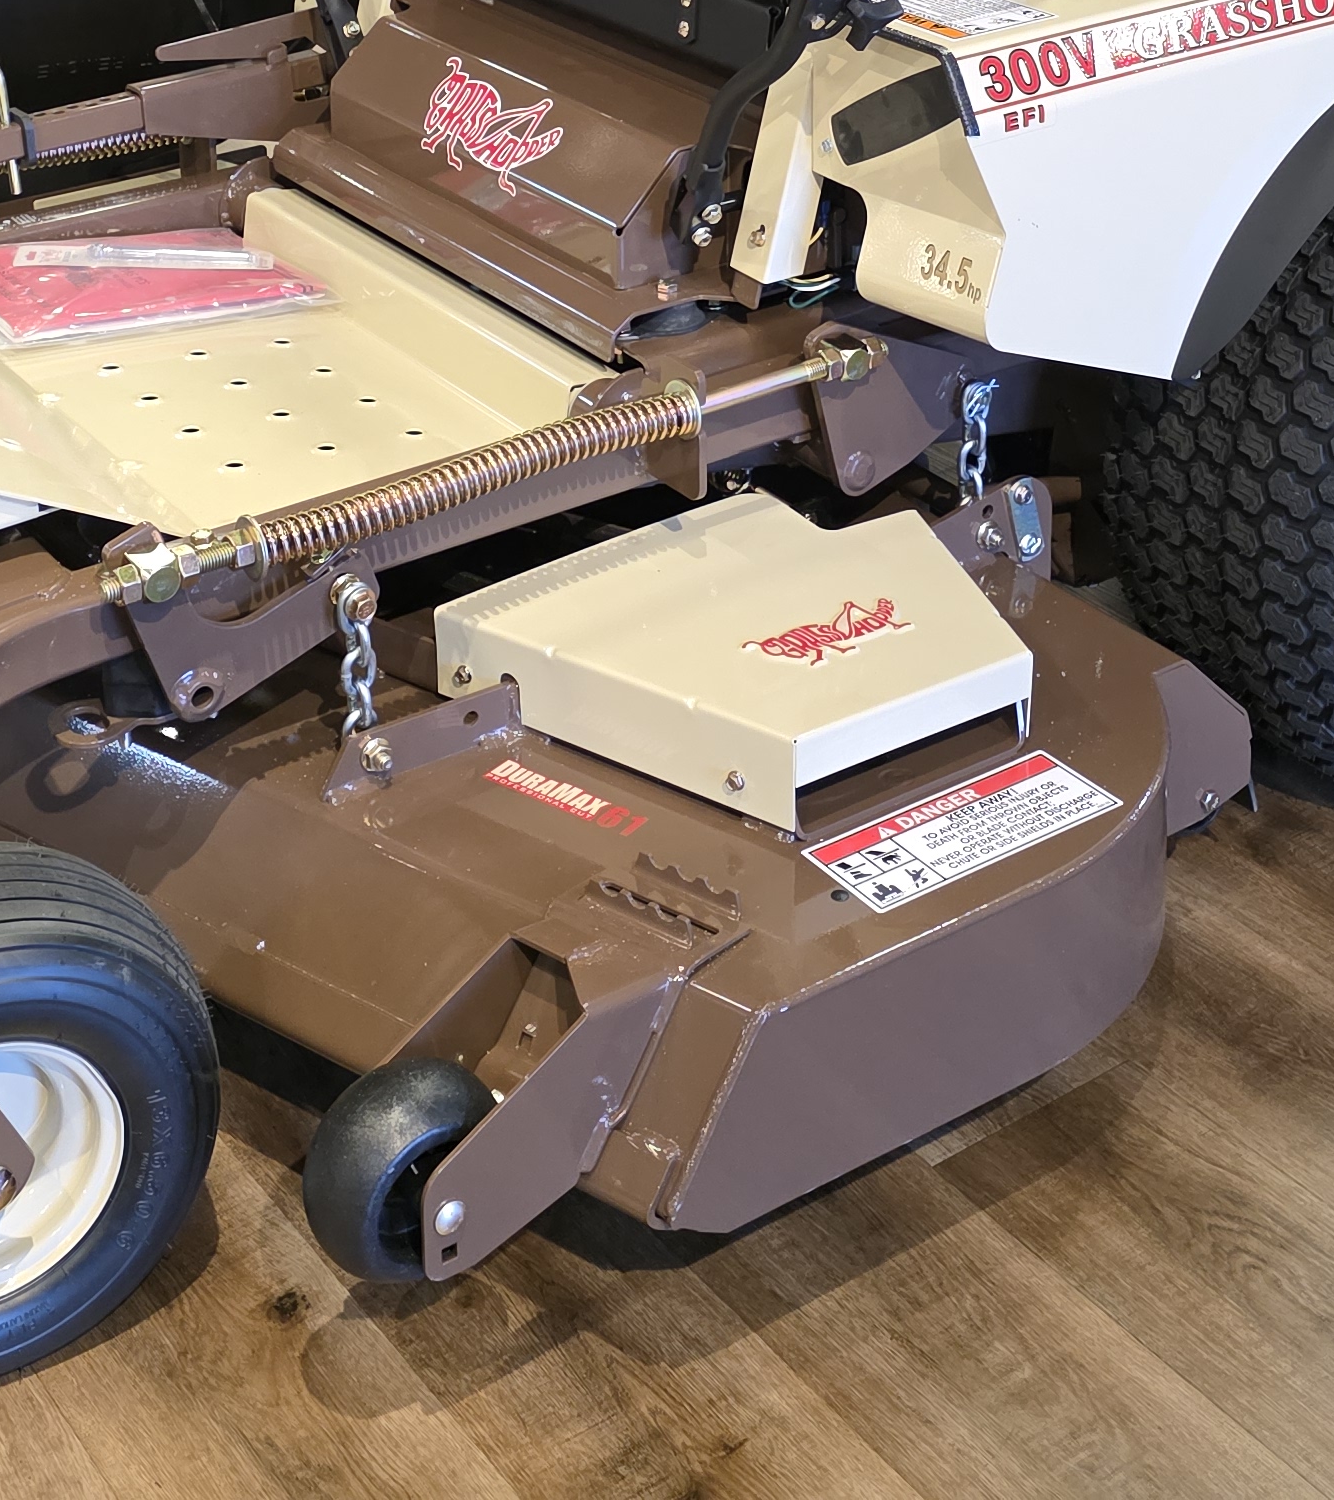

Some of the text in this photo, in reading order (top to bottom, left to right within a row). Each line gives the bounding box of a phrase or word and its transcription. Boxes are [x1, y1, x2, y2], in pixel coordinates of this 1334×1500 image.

[979, 30, 1097, 103] 300V
[1003, 104, 1046, 133] EFI
[484, 772, 594, 821] PROFESSIONAL CUT
[490, 759, 649, 837] DURAMAX 61
[898, 788, 982, 830] DANGER
[922, 780, 1057, 842] TO AVOID SERIOUS INJURY OR
[926, 784, 1069, 851] DEATH FROM THROWN OBJECTS
[945, 788, 1019, 823] KEEP AWAY!
[929, 850, 963, 868] NEVER
[962, 832, 1004, 853] OPERATE
[1003, 812, 1045, 834] WITHOUT
[1044, 789, 1099, 817] DISCHARGE
[948, 852, 980, 869] CHUTE
[980, 844, 997, 855] OR
[995, 835, 1019, 848] SIDE
[1019, 819, 1055, 839] SHIELDS
[1053, 814, 1066, 822] IN
[1064, 801, 1098, 819] PLACE.
[960, 835, 977, 845] OR
[977, 821, 1007, 838] BLADE
